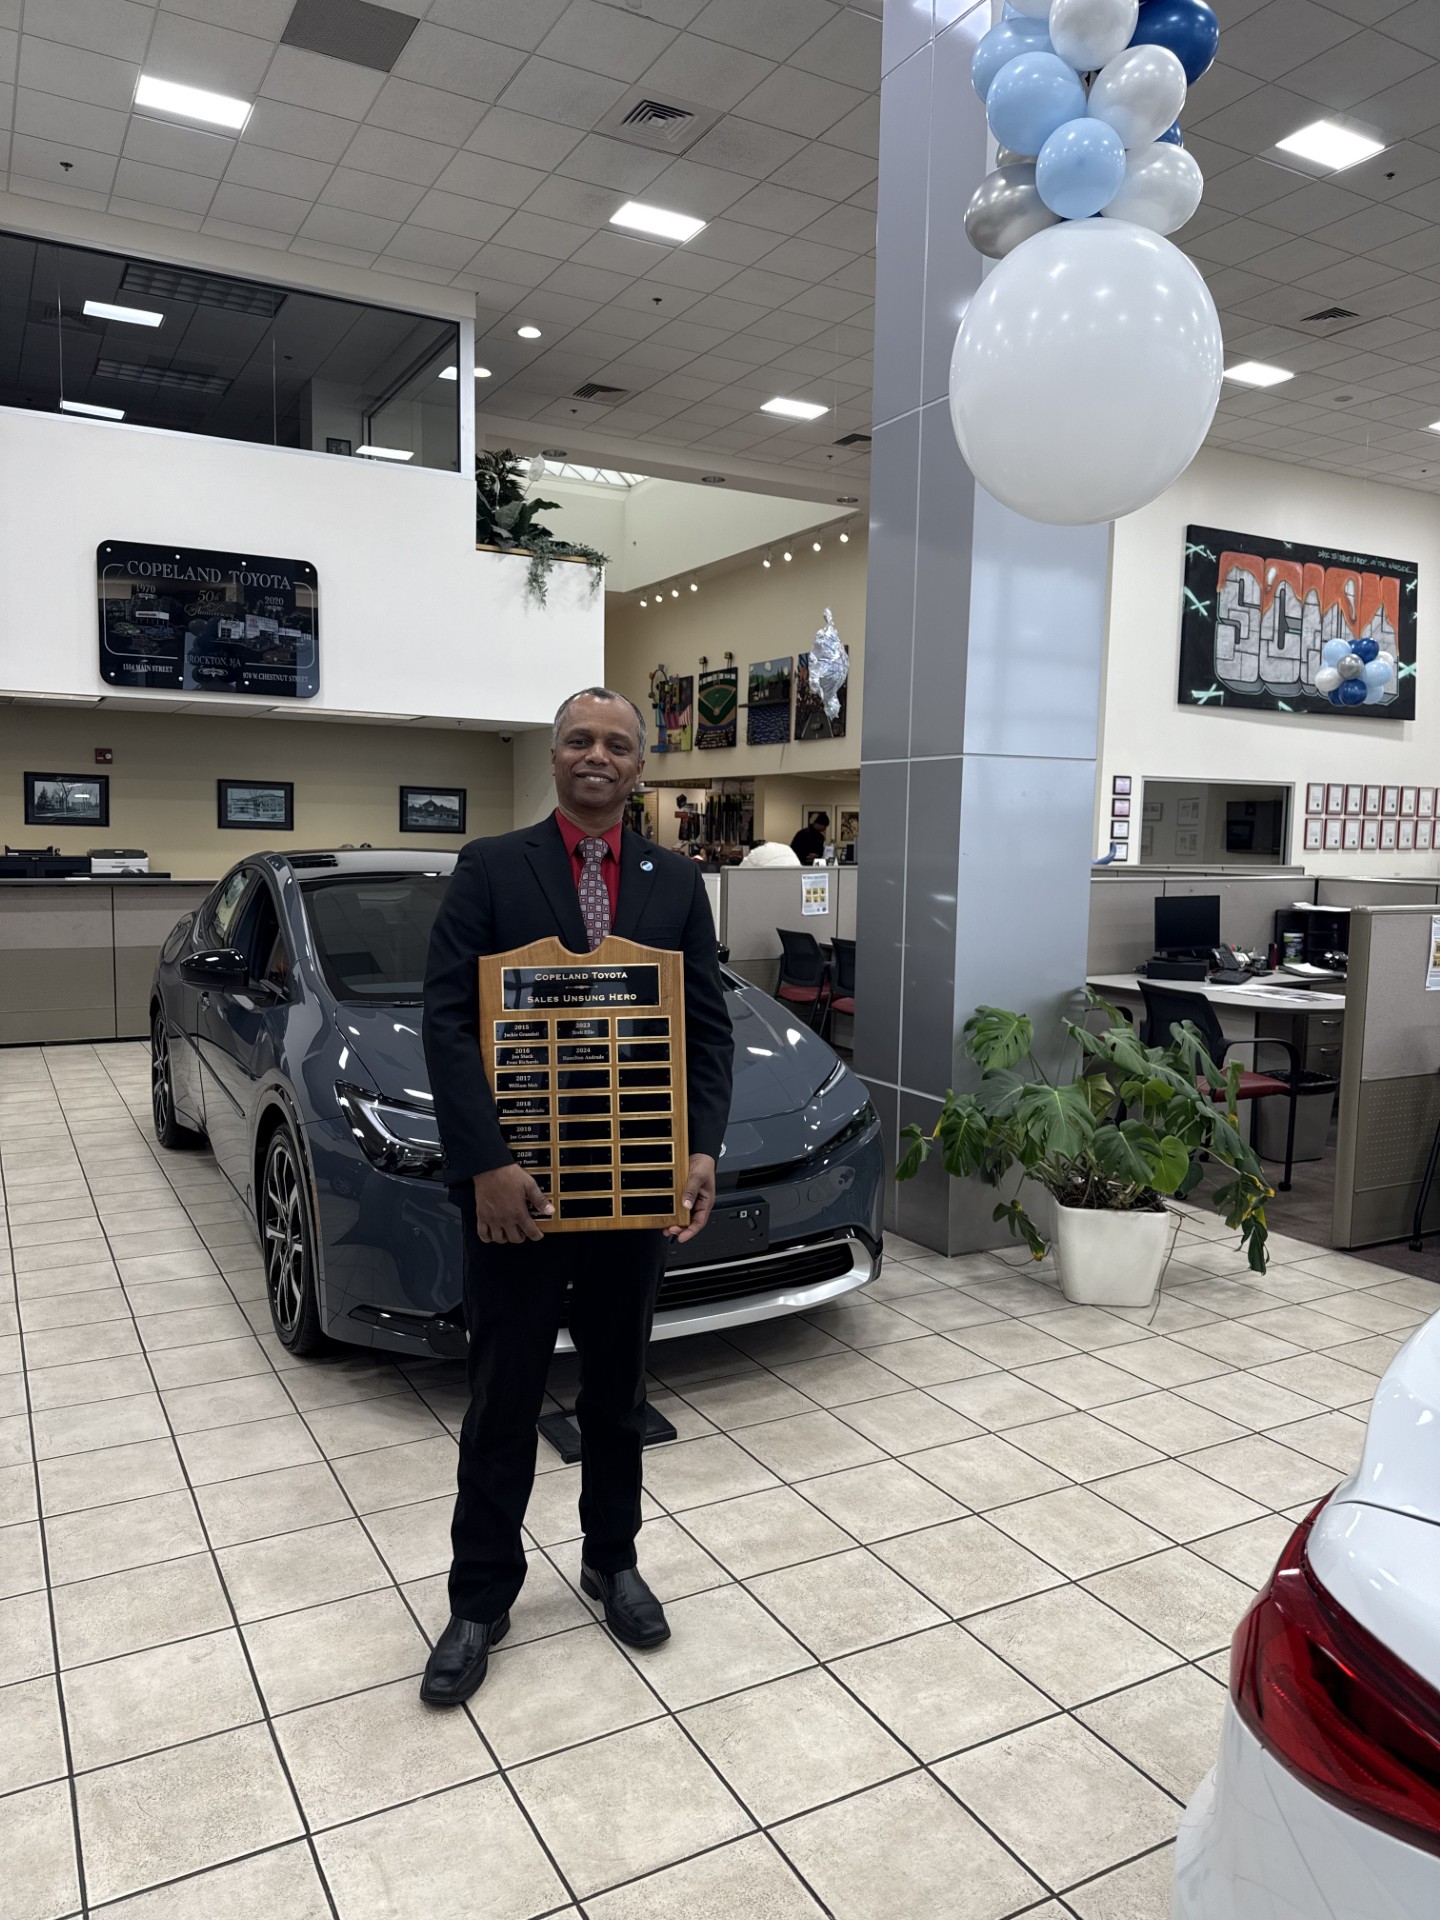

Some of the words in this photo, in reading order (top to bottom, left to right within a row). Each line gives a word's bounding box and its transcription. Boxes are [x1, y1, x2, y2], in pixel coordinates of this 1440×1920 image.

[126, 560, 222, 584] COPELAND
[228, 570, 292, 590] TOYOTA
[135, 583, 156, 594] 1970
[264, 595, 284, 606] 2020
[229, 656, 242, 668] MA
[135, 663, 151, 672] MAIN
[151, 665, 174, 673] STREET
[258, 673, 288, 682] CHESTNUT
[288, 675, 309, 683] STREET
